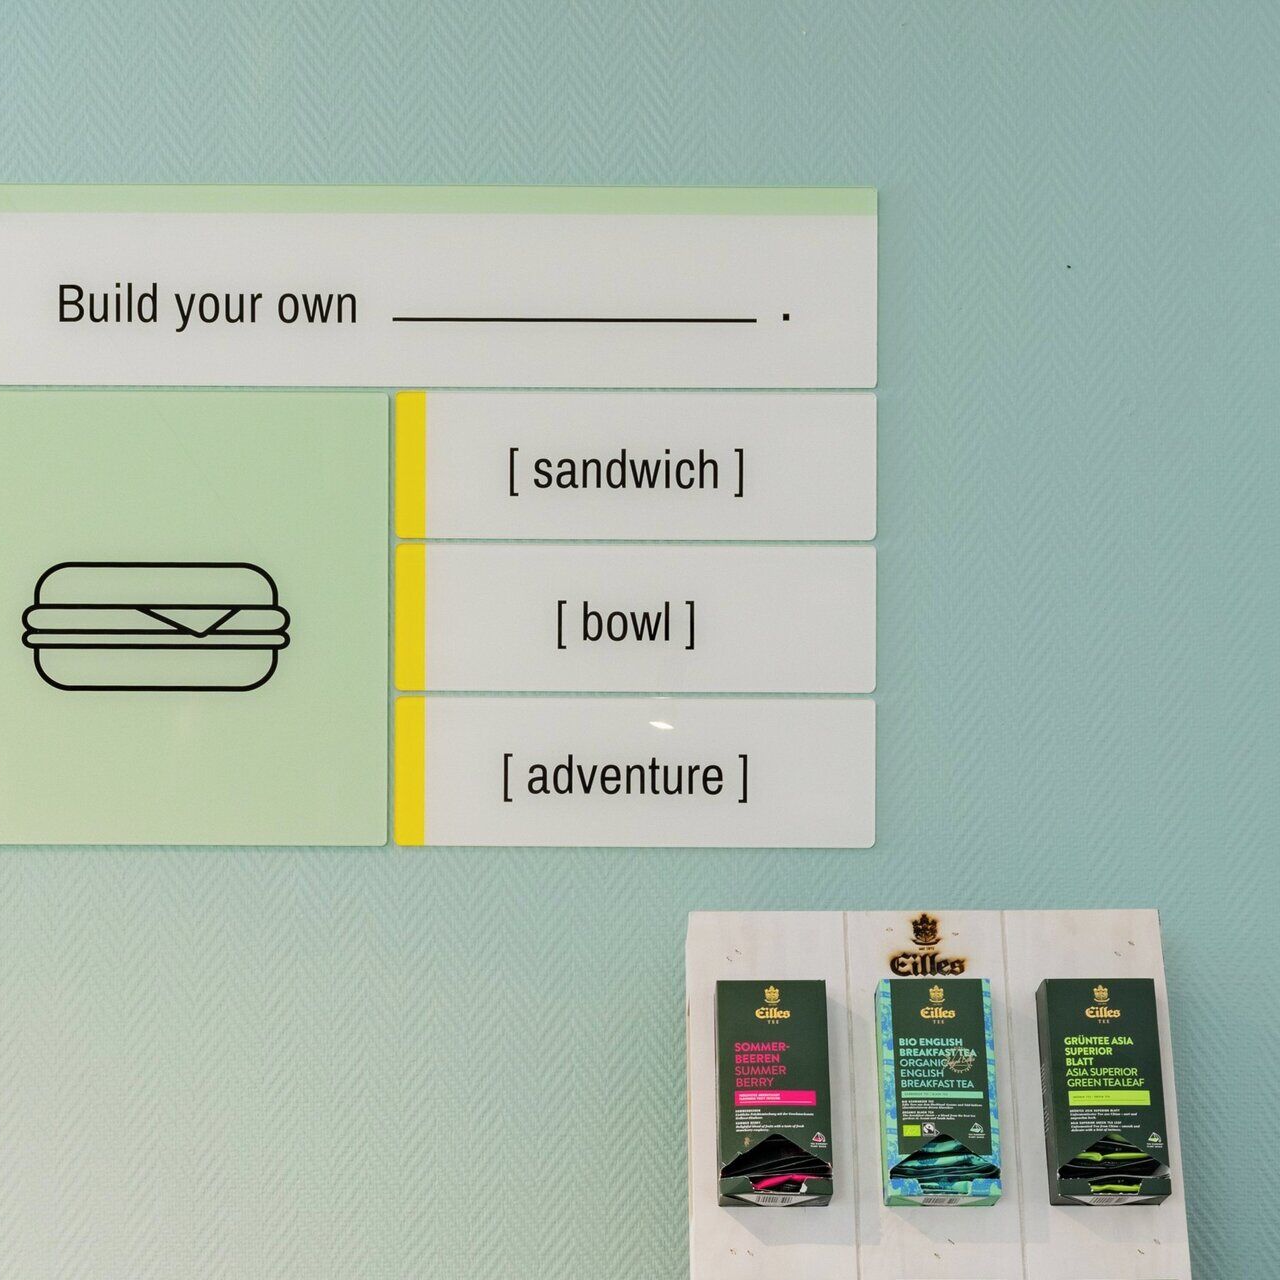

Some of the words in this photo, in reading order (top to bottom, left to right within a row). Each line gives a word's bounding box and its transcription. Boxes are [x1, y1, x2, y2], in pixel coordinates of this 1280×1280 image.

[58, 282, 158, 324] Build
[174, 292, 263, 333] your
[277, 292, 357, 324] own
[533, 448, 719, 490] sandwich
[582, 600, 670, 642] bowl
[527, 753, 724, 796] adventure
[890, 952, 966, 976] Eilles
[755, 1006, 791, 1019] Eilles
[920, 1006, 956, 1019] Eilles
[1085, 1006, 1121, 1018] Eilles
[899, 1038, 917, 1046] BIO
[919, 1038, 963, 1046] ENGLISH
[1064, 1035, 1110, 1045] GRÜNTEE
[1111, 1036, 1134, 1045] ASIA
[734, 1042, 790, 1052] SOMMER-
[1064, 1047, 1113, 1055] SUPERIOR
[899, 1048, 956, 1057] BREAKFAST
[957, 1048, 977, 1057] TEA
[735, 1054, 780, 1063] BEEREN
[900, 1058, 948, 1067] ORGANIC
[1066, 1057, 1094, 1066] BLATT
[735, 1065, 787, 1075] SUMMER
[900, 1069, 944, 1077] ENGLISH
[1065, 1067, 1089, 1076] ASIA
[1090, 1067, 1138, 1076] SUPERIOR
[736, 1077, 774, 1087] BERRY
[901, 1080, 955, 1088] BREAKFAST
[956, 1080, 975, 1088] TEA
[1067, 1078, 1102, 1087] GREEN
[1102, 1078, 1121, 1087] TEA
[1122, 1078, 1145, 1087] LEAF
